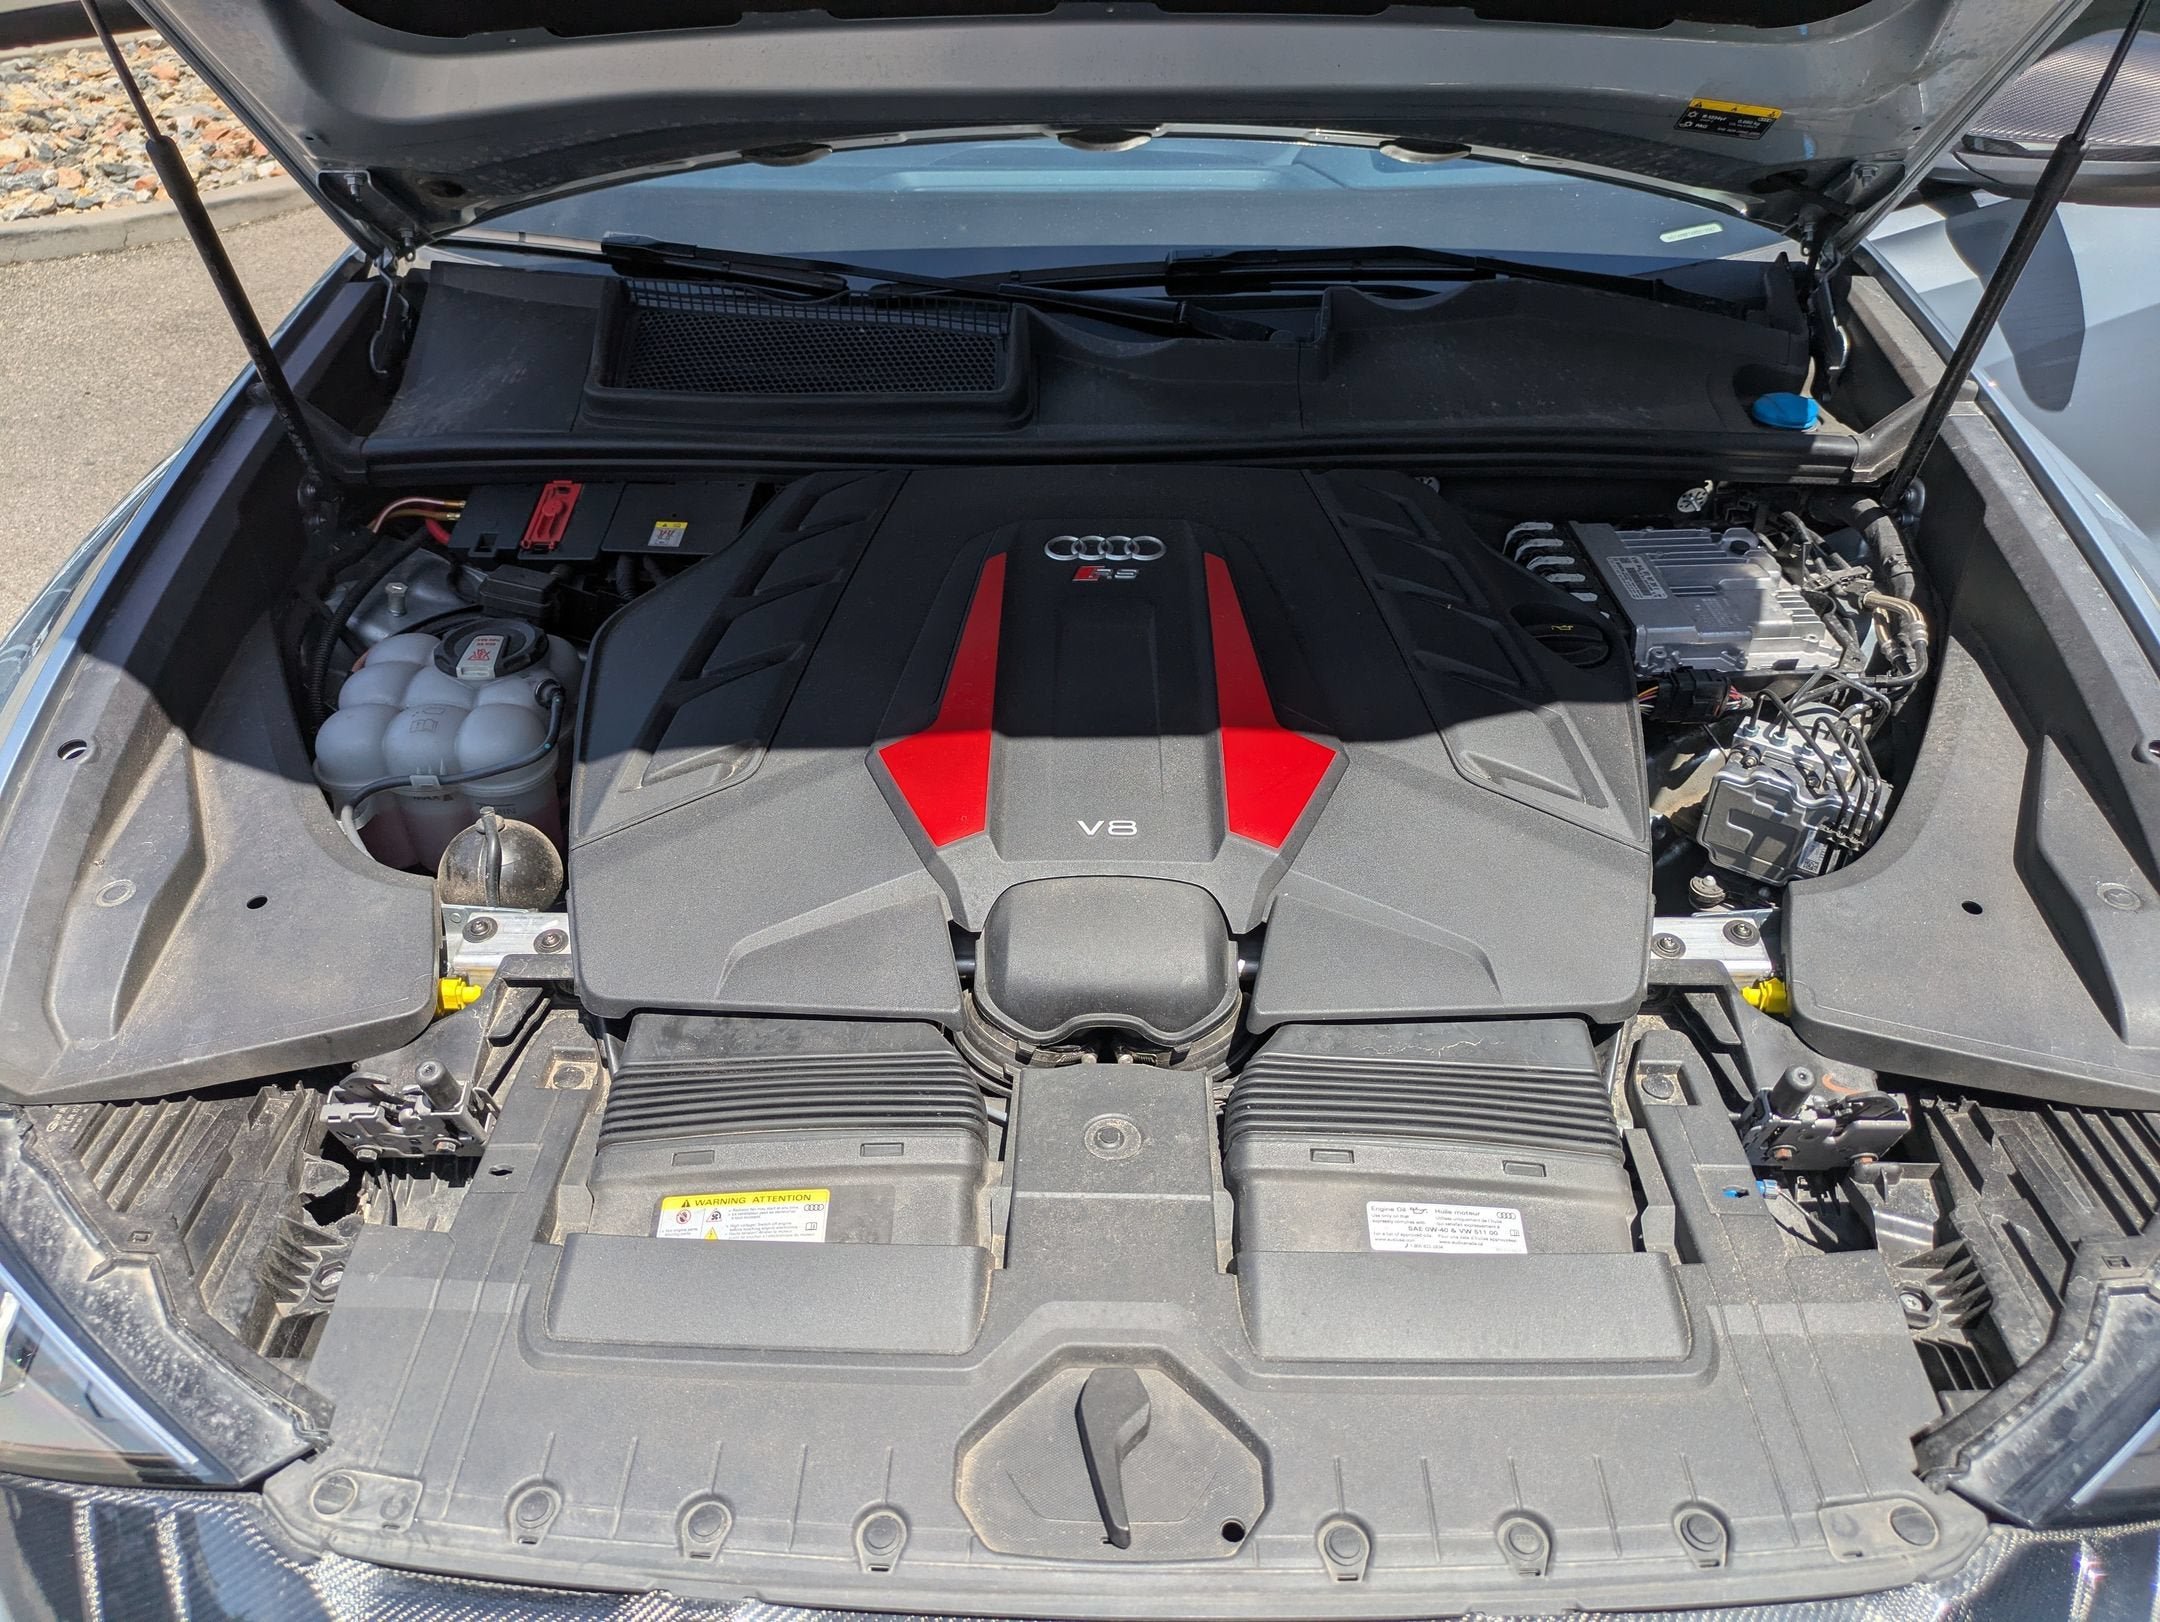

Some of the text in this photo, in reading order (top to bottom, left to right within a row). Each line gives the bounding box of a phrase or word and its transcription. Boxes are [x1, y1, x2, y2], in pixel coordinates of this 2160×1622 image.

[1077, 820, 1138, 836] V8
[695, 1194, 812, 1206] WARNING ATTENTION
